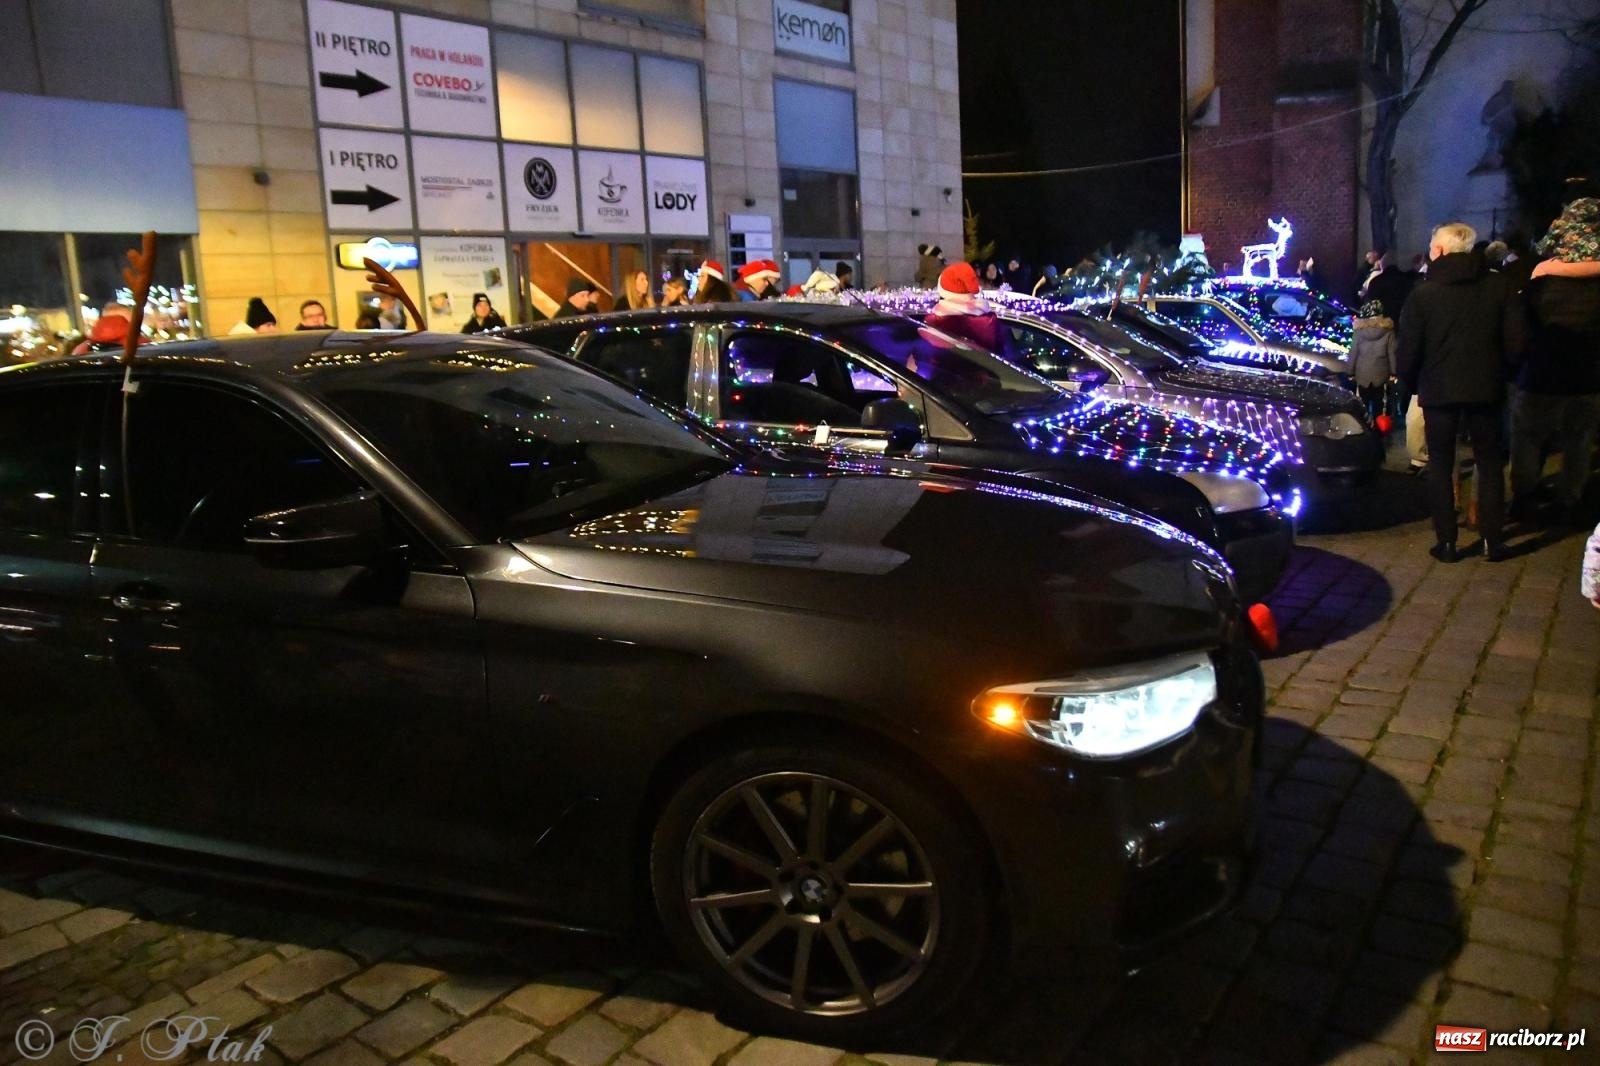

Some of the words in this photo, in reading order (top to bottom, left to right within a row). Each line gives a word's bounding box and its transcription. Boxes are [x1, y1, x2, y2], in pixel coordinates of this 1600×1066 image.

[332, 33, 391, 57] PIĘTRO
[413, 72, 472, 92] COVEBO
[340, 151, 398, 171] PIĘTRO
[654, 191, 697, 211] LODY
